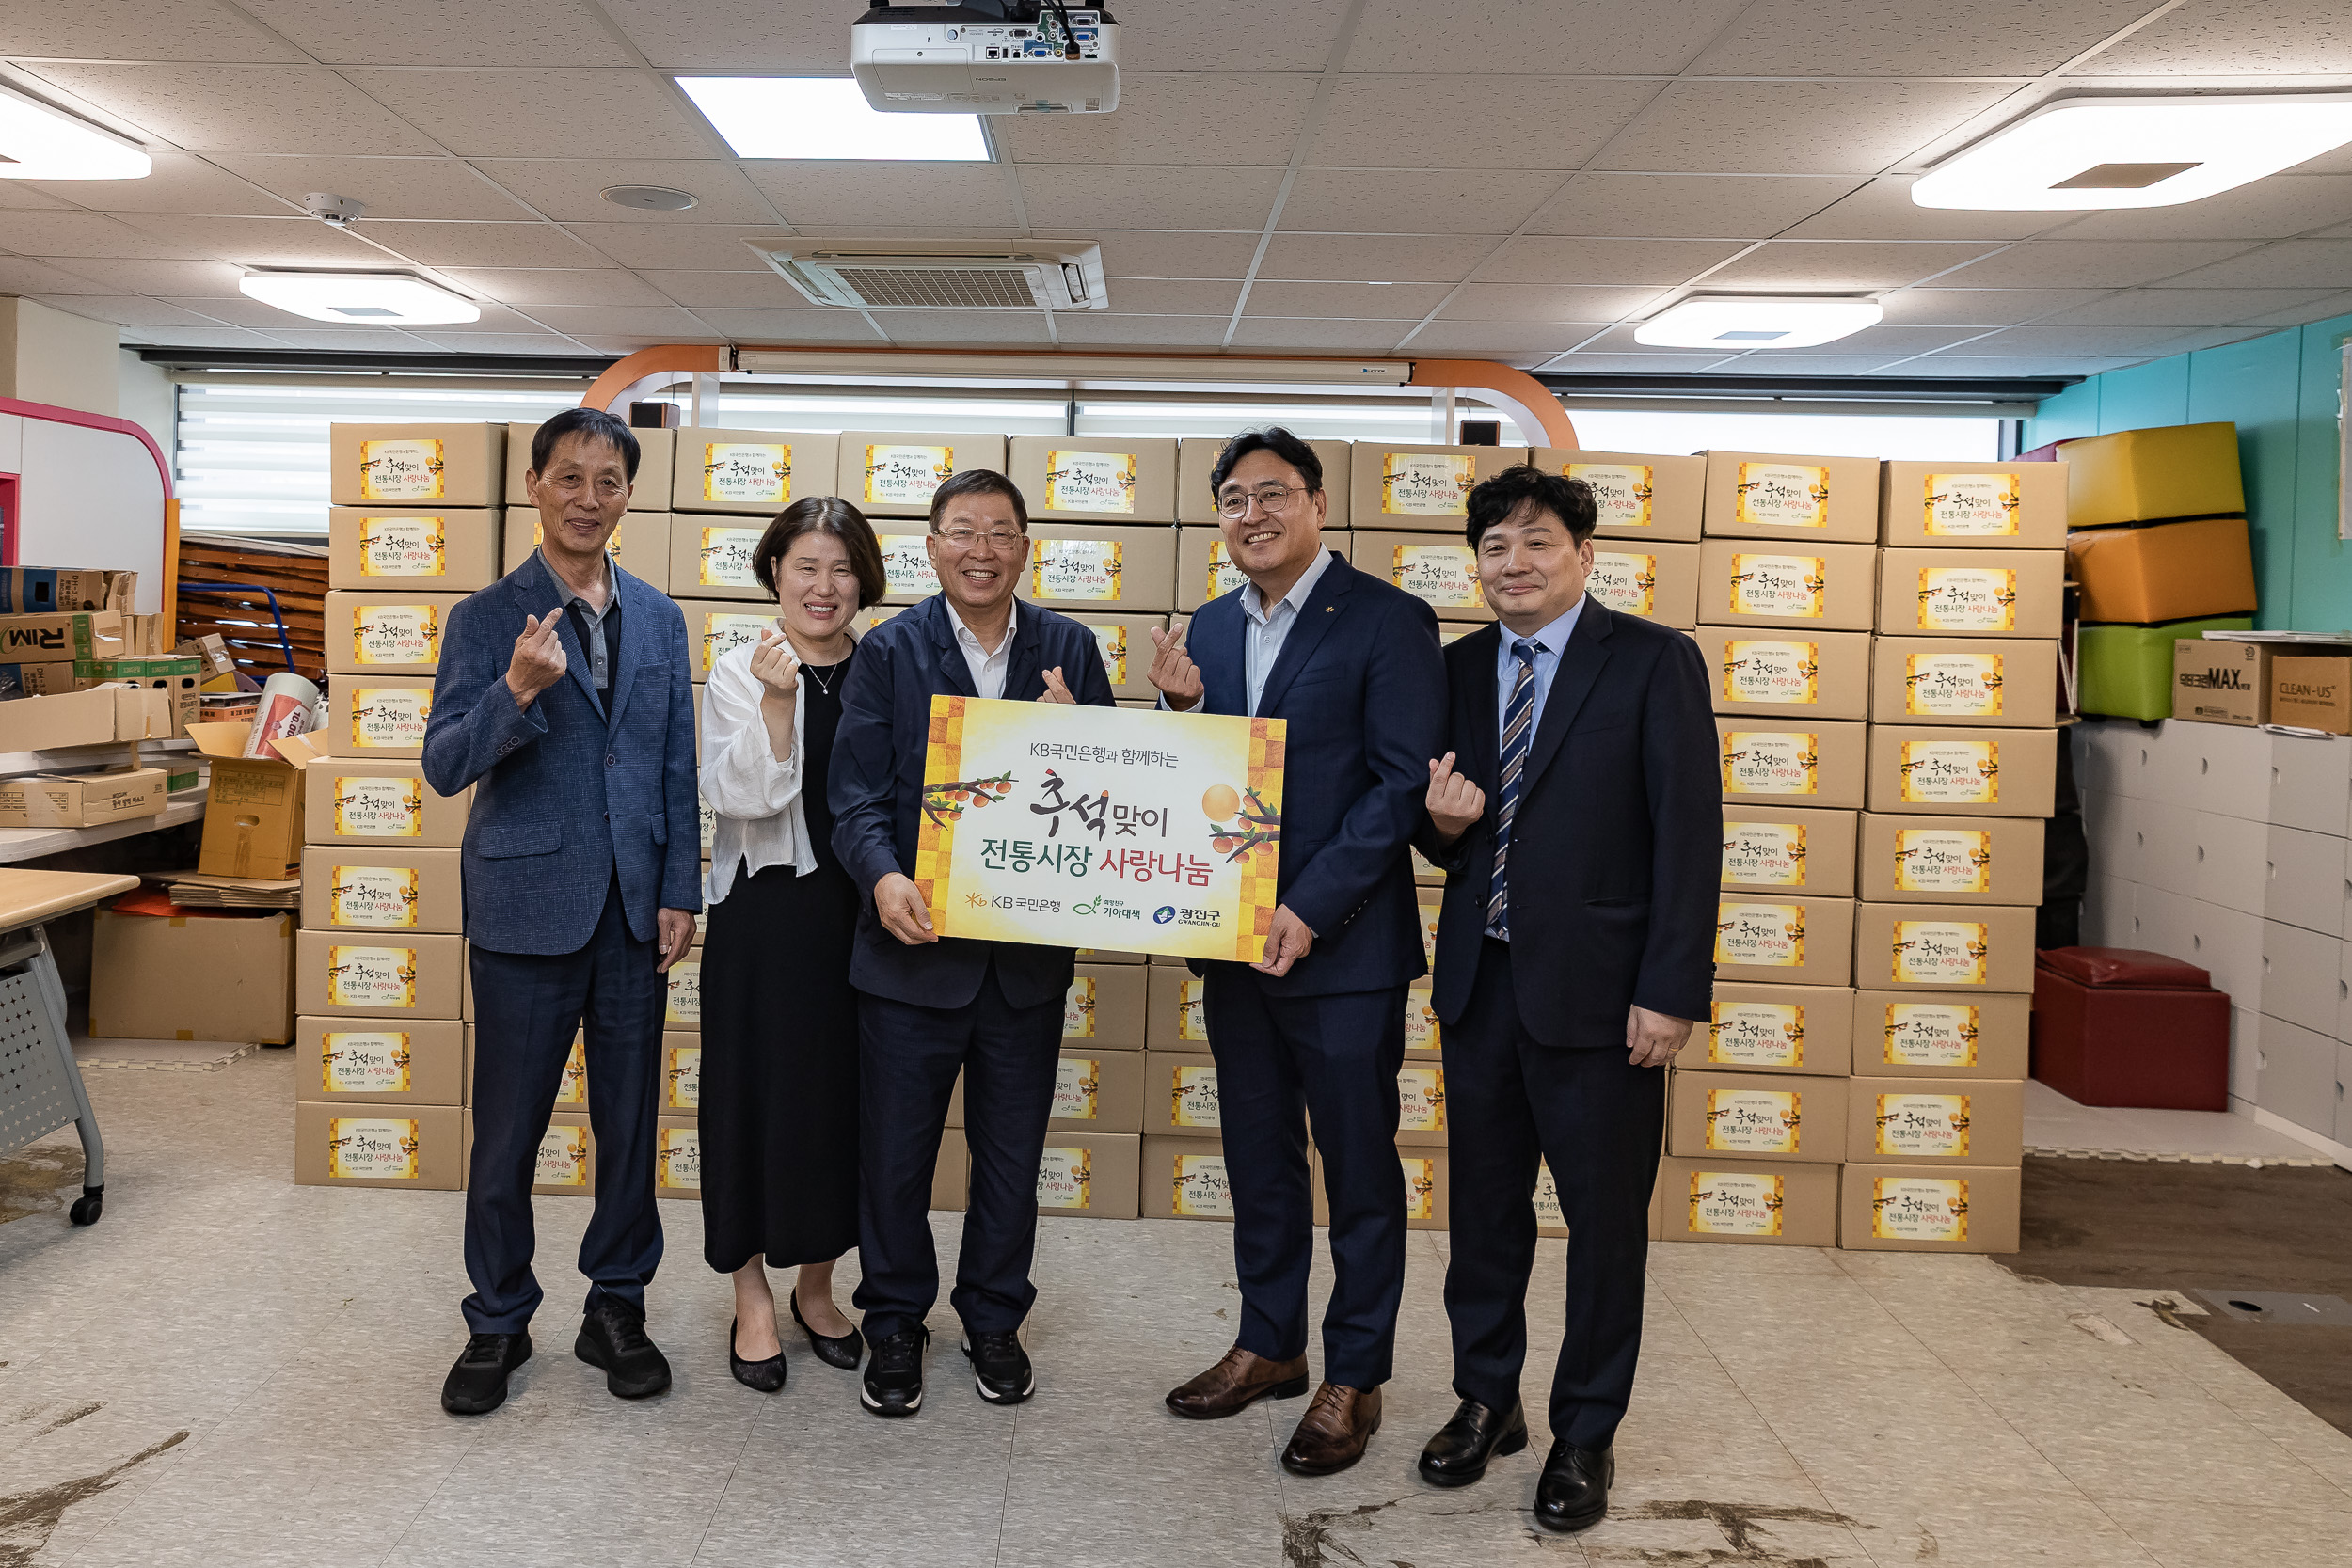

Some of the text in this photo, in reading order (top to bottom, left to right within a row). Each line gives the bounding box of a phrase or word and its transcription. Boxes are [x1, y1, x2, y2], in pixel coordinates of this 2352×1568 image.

[386, 456, 418, 473] 추석맞이
[730, 459, 765, 477] 추석맞이
[893, 460, 928, 478] 추석맞이
[719, 477, 775, 486] 전통시장 사랑나눔
[881, 478, 938, 487] 전통시장 사랑나눔
[1073, 468, 1109, 486] 추석맞이
[1410, 471, 1447, 489] 추석맞이
[1061, 485, 1119, 496] 전통시장 사랑나눔
[1398, 489, 1457, 499] 전통시장 사랑나눔
[1765, 480, 1801, 500] 추석맞이
[1607, 501, 1636, 509] 사랑나눔
[1752, 498, 1812, 510] 전통시장 사랑나눔
[1953, 491, 1990, 509] 추석맞이
[1941, 510, 2002, 519] 전통시장 사랑나눔
[386, 534, 419, 550] 추석맞이
[375, 551, 430, 560] 전통시장 사랑나눔
[727, 544, 754, 561] 추석맞
[715, 562, 743, 571] 전통시장
[1060, 556, 1096, 574] 추석맞이
[1420, 563, 1457, 580] 추석맞이
[887, 570, 938, 579] 전통시장 사랑나
[1048, 574, 1106, 584] 전통시장 사랑나눔
[1759, 571, 1796, 590] 추석맞이
[1408, 581, 1468, 590] 전통시장 사랑나눔
[1609, 589, 1638, 598] 사랑나눔
[1746, 589, 1807, 600] 전통시장 사랑나눔
[1948, 585, 1987, 603] 추석맞이
[1935, 604, 1998, 613] 전통시장 사랑나눔
[379, 622, 412, 638] 추석맞이
[368, 640, 394, 648] 전통시장
[1753, 658, 1789, 676] 추석맞이
[1740, 676, 1801, 686] 전통시장 사랑나눔
[1935, 670, 1973, 688] 추석맞이
[1922, 689, 1985, 698] 전통시장 사랑나눔
[380, 706, 412, 723] 추석맞이
[368, 724, 395, 732] 전통시장
[1030, 743, 1178, 768] KB국민은행과 함께하는
[1752, 749, 1788, 767] 추석맞이
[1740, 767, 1801, 777] 전통시장 사랑나눔
[1930, 758, 1968, 776] 추석맞이
[1917, 777, 1981, 786] 전통시장 사랑나눔
[361, 793, 395, 811] 추석맞이
[1030, 768, 1168, 841] 추석맞이
[350, 811, 406, 820] 전통시장 사랑나눔
[1741, 839, 1777, 857] 추석맞이
[981, 838, 1213, 887] 전통시장 사랑나눔
[1729, 857, 1789, 867] 전통시장 사랑나눔
[1924, 846, 1962, 865] 추석맞이
[1912, 865, 1941, 874] 전통시장
[358, 883, 392, 901] 추석맞이
[346, 900, 403, 911] 전통시장 사랑나눔
[991, 895, 1061, 913] KB 국민은행
[1103, 907, 1141, 920] 기아대책
[1180, 908, 1221, 921] 광진구
[1741, 920, 1777, 938] 추석맞이
[1729, 938, 1789, 948] 전통시장 사랑나눔
[1922, 938, 1959, 957] 추석맞이
[1909, 957, 1939, 966] 전통시장
[356, 963, 390, 981] 추석맞이
[344, 980, 400, 991] 전통시장 사랑나눔
[1739, 1019, 1777, 1039] 추석맞이
[1914, 1020, 1950, 1039] 추석맞이
[1726, 1037, 1756, 1048] 전통시장
[1901, 1039, 1930, 1048] 전통시장
[348, 1049, 383, 1066] 추석맞이
[337, 1067, 364, 1075] 전통시장
[1736, 1107, 1773, 1126] 추석맞이
[1905, 1111, 1942, 1129] 추석맞이
[1723, 1125, 1753, 1135] 전통시장
[1893, 1129, 1922, 1139] 전통시장
[358, 1135, 392, 1152] 추석맞이
[346, 1153, 374, 1162] 전통시장
[1719, 1189, 1756, 1208] 추석맞이
[1903, 1195, 1940, 1214] 추석맞이
[1706, 1207, 1736, 1217] 전통시장
[1890, 1213, 1920, 1223] 전통시장
